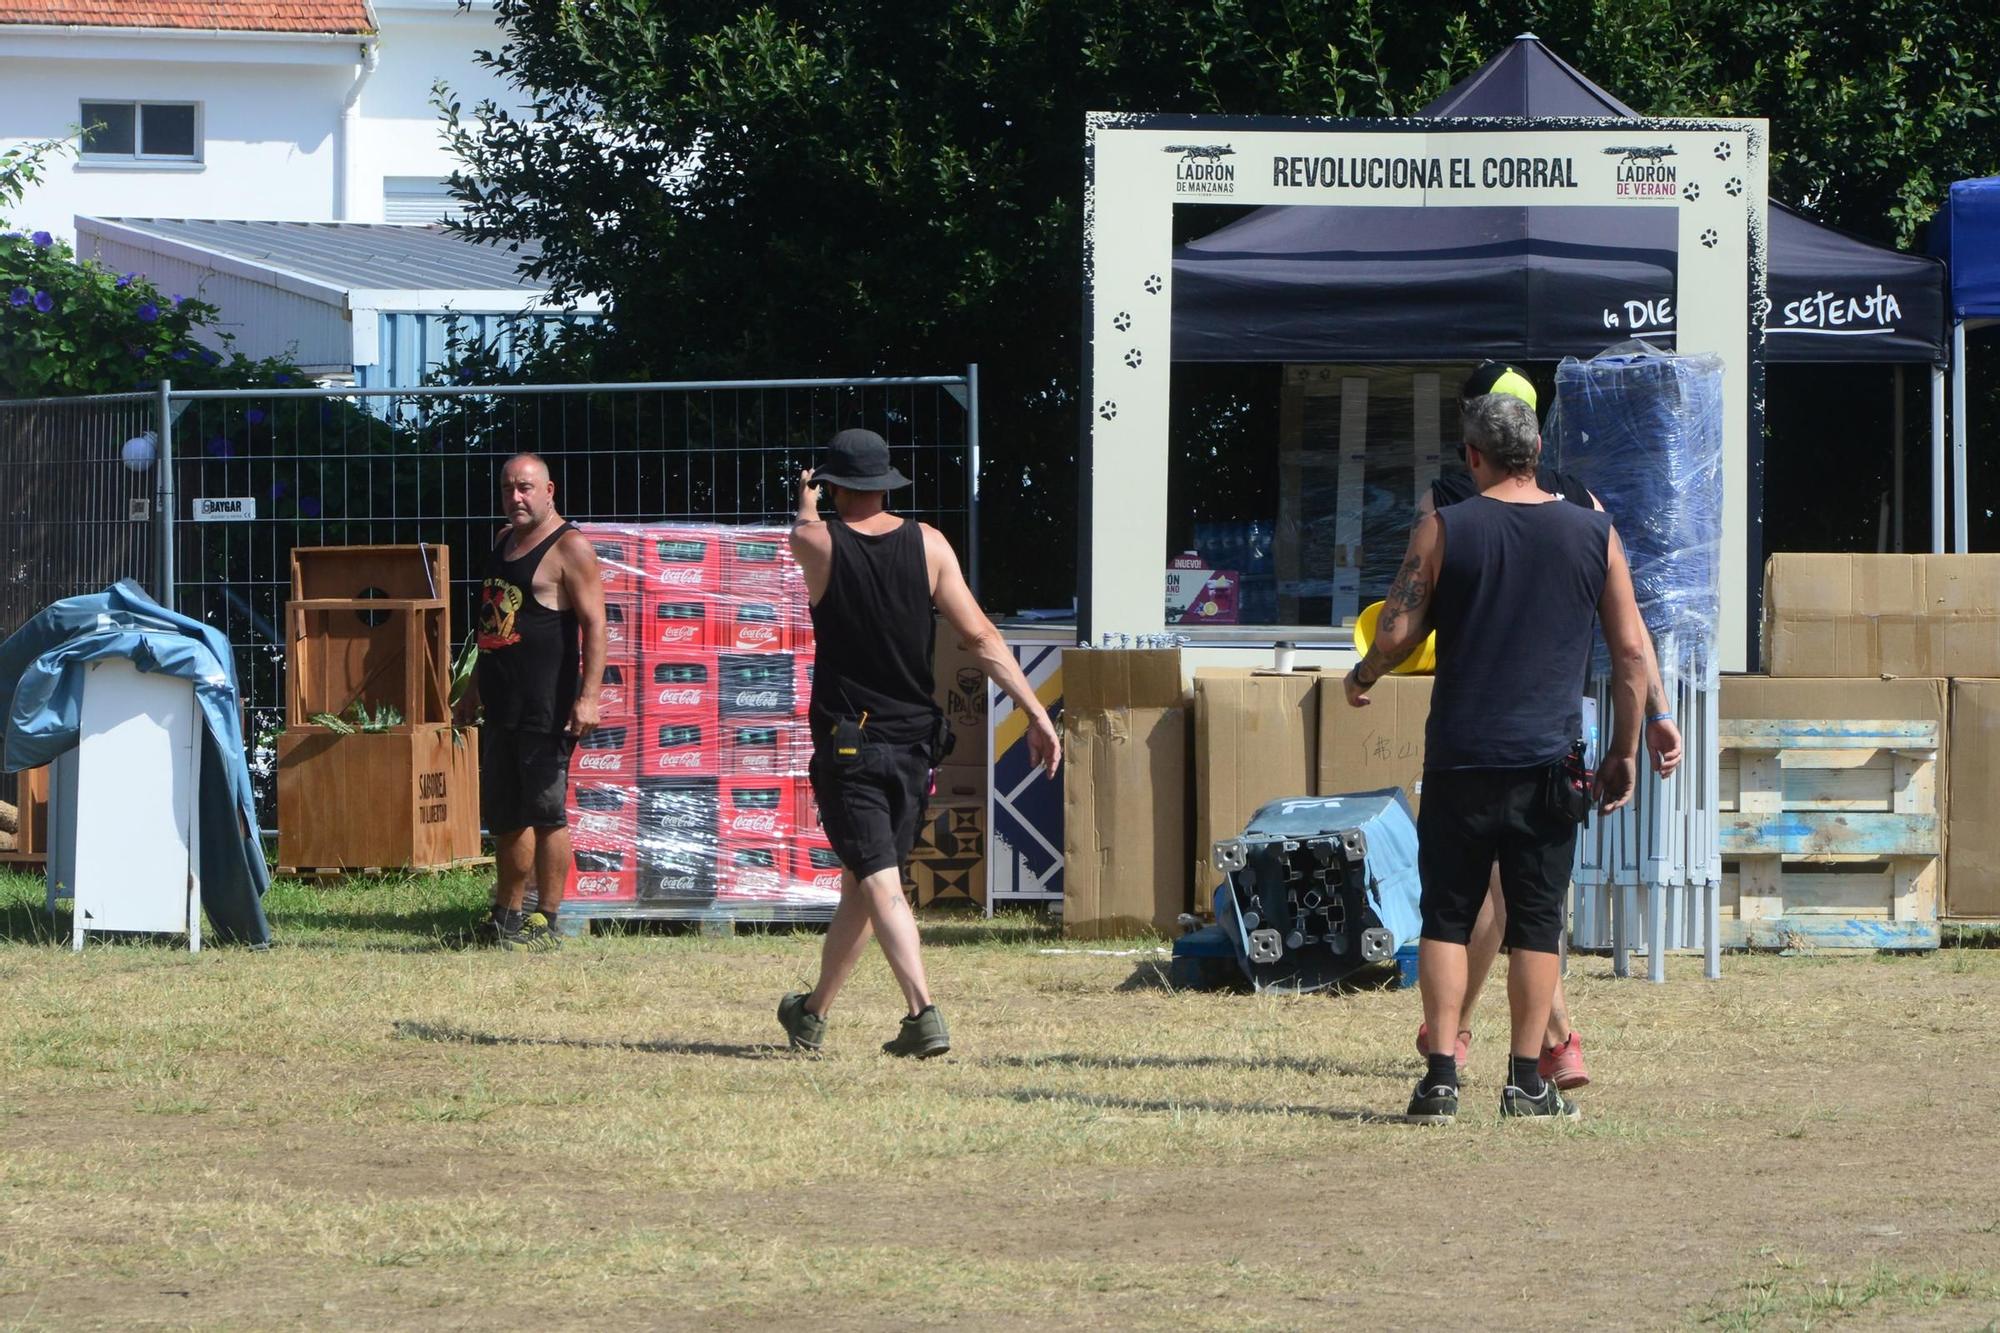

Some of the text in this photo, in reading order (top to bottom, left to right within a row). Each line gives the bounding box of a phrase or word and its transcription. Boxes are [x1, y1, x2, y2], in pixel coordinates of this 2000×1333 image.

[1177, 162, 1234, 181] LADRÓN
[1273, 156, 1578, 189] REVOLUCIONA EL CORRAL
[1616, 164, 1676, 182] LADRÓN
[1176, 182, 1234, 193] DE MANZANAS
[1616, 183, 1676, 196] DE VERANO
[1624, 297, 1677, 329] DIE
[210, 501, 242, 513] BAYGAR
[1167, 572, 1180, 585] ÓN
